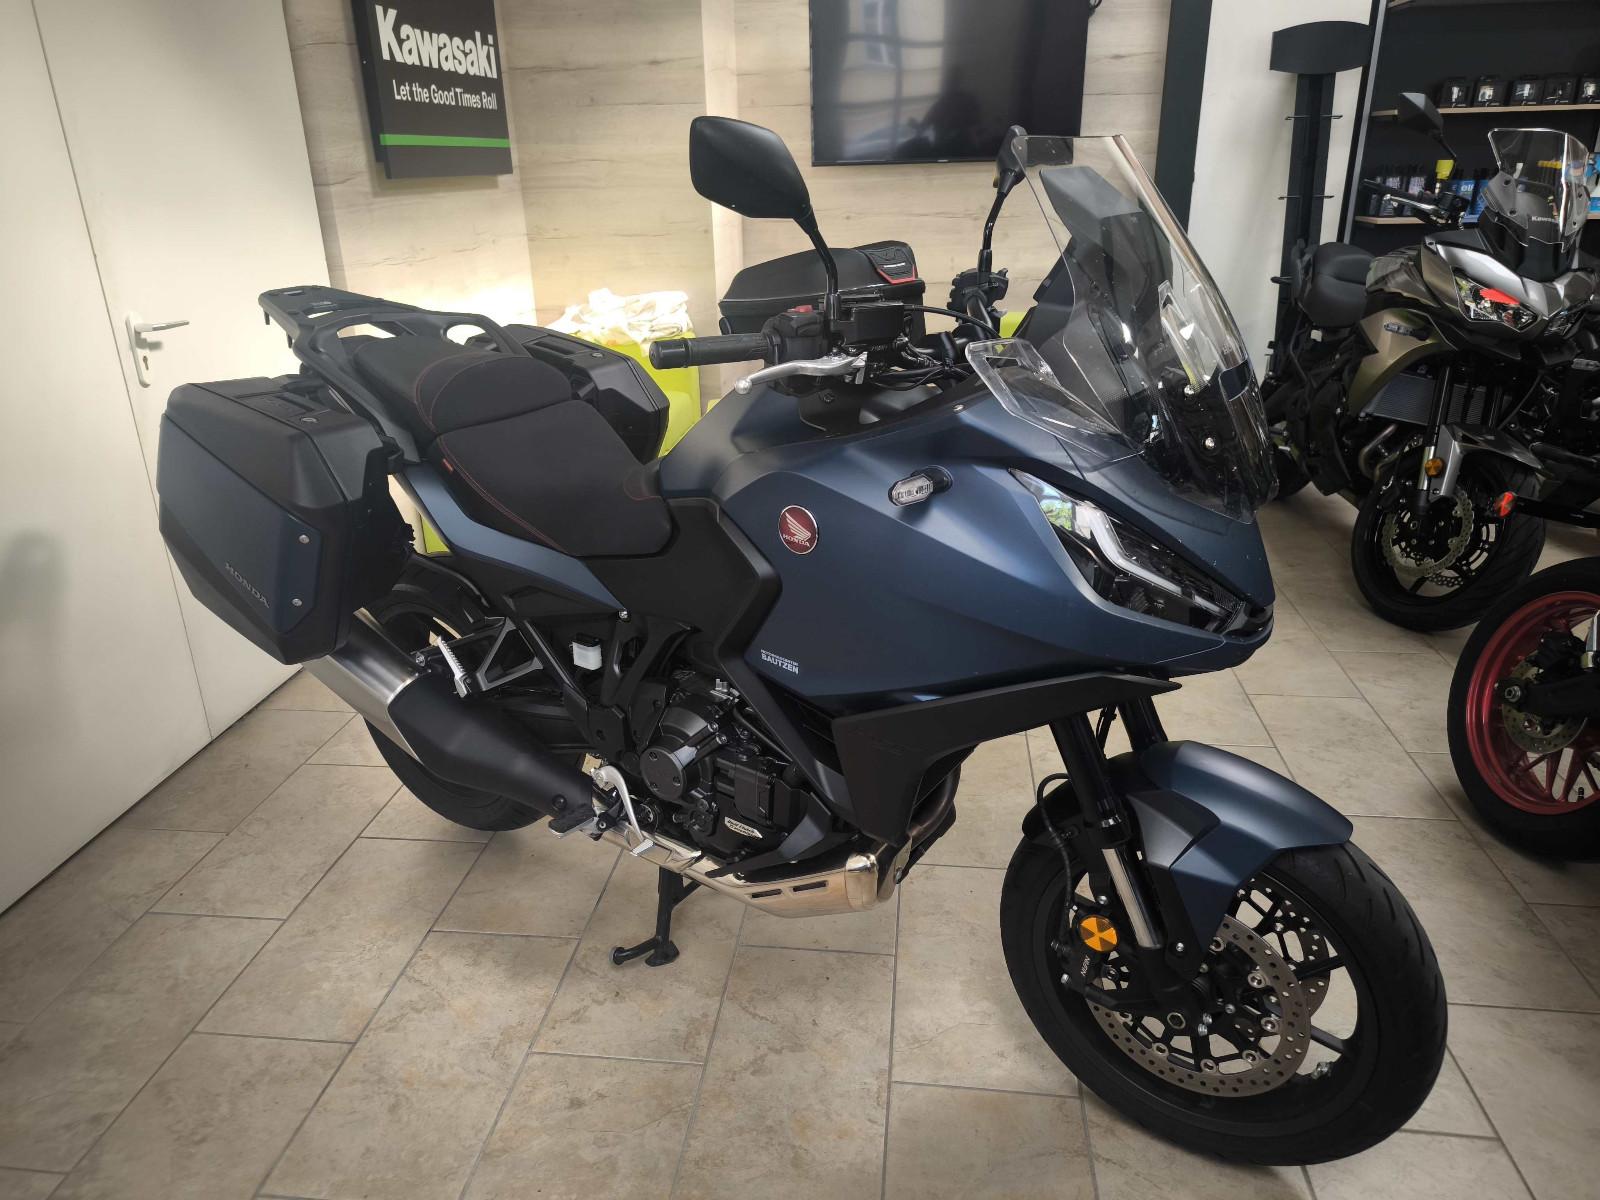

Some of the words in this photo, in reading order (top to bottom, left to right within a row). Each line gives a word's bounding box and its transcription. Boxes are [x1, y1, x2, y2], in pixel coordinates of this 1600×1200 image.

[375, 4, 497, 79] Kawasaki
[392, 79, 411, 101] Let
[412, 82, 430, 103] the
[430, 84, 456, 106] Good
[455, 88, 482, 109] Times
[481, 91, 498, 111] Roll
[783, 533, 810, 547] HONDA
[225, 561, 270, 609] HONDA
[761, 653, 799, 675] BAUTZEN
